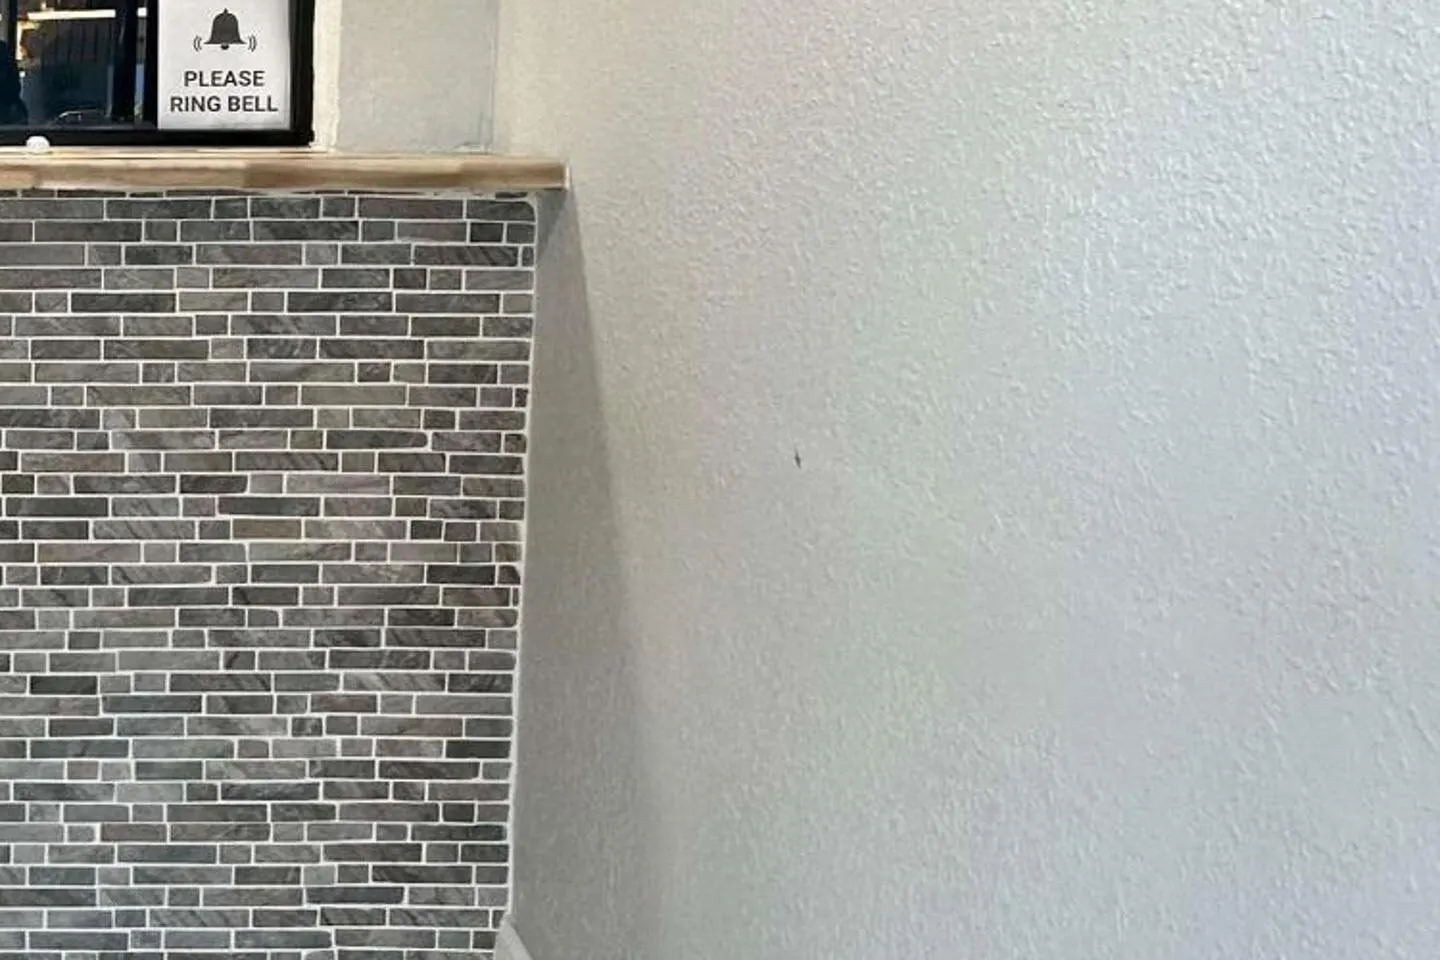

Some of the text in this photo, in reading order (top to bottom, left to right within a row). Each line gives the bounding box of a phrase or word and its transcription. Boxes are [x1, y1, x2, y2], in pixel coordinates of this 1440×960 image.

[184, 70, 266, 87] PLEASE
[170, 95, 278, 112] RING BELL
